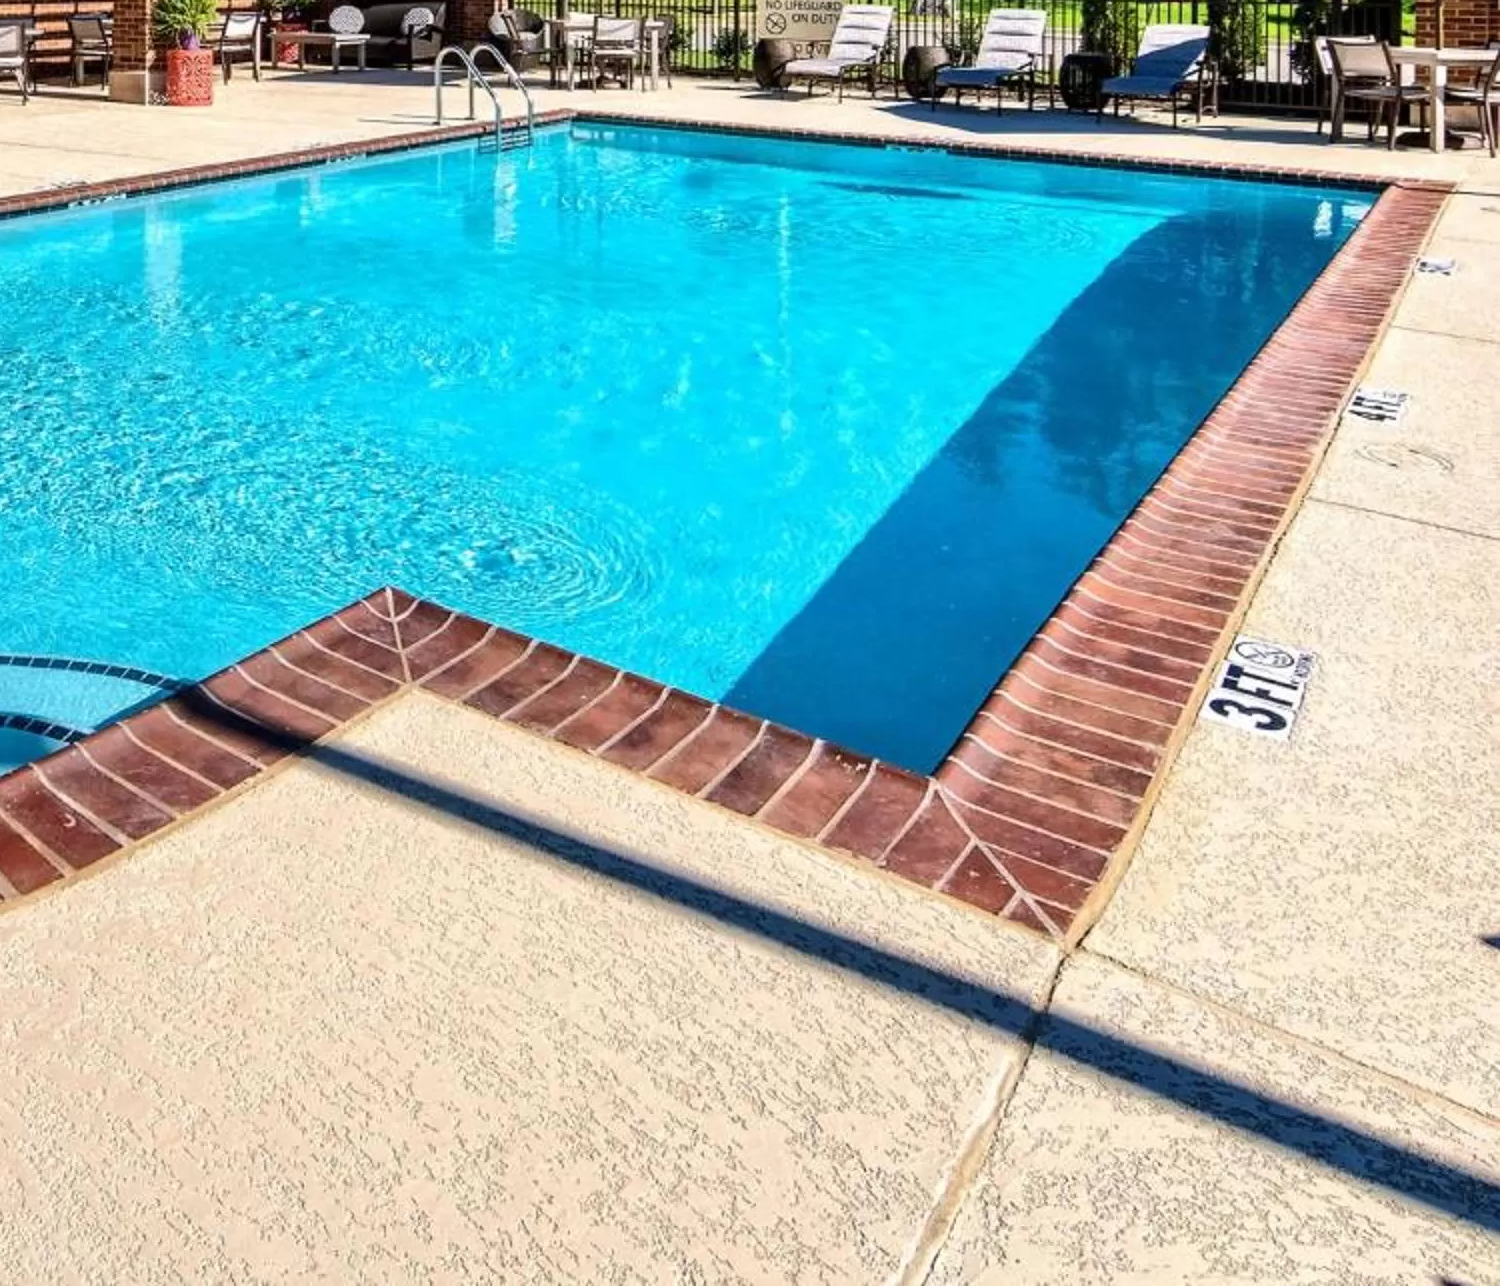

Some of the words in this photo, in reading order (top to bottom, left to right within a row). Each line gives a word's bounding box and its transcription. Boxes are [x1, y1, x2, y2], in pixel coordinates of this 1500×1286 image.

[765, 0, 782, 10] NO
[785, 0, 842, 12] LIFEGUARD
[791, 13, 808, 23] ON
[812, 14, 840, 24] DUTY
